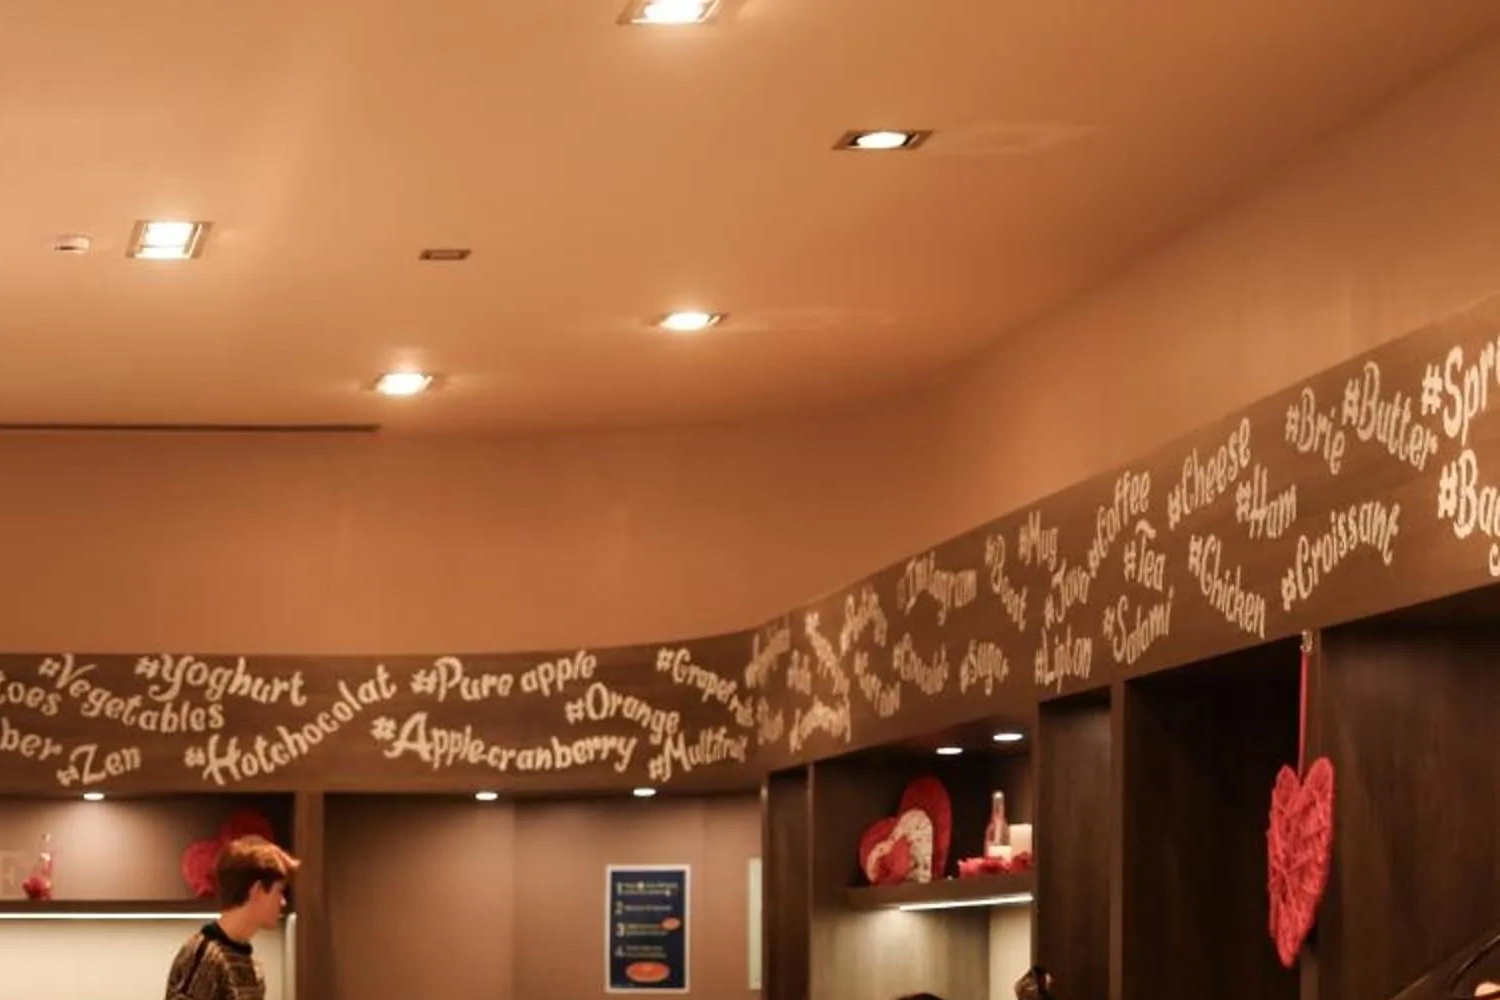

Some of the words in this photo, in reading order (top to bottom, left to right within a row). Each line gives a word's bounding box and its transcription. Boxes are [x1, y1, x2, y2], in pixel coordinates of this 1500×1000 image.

[1285, 387, 1345, 475] #Brie
[1342, 361, 1439, 471] #Butter
[1421, 336, 1500, 447] #Spr
[1167, 417, 1251, 530] #Cheese
[1235, 463, 1297, 539] #Ham
[1124, 520, 1166, 592] #Tea
[1189, 534, 1266, 640] #Chicken
[1281, 500, 1401, 612] #Croissant
[1035, 625, 1093, 694] #Lipton
[1103, 585, 1175, 664] #Salami
[38, 653, 225, 734] #Vegetables
[133, 654, 307, 708] #Yoghurt
[410, 656, 513, 702] #Pure
[520, 649, 597, 697] apple
[564, 682, 680, 744] #Orange
[56, 744, 141, 786] #Zen
[183, 664, 397, 786] #Hotchocolat
